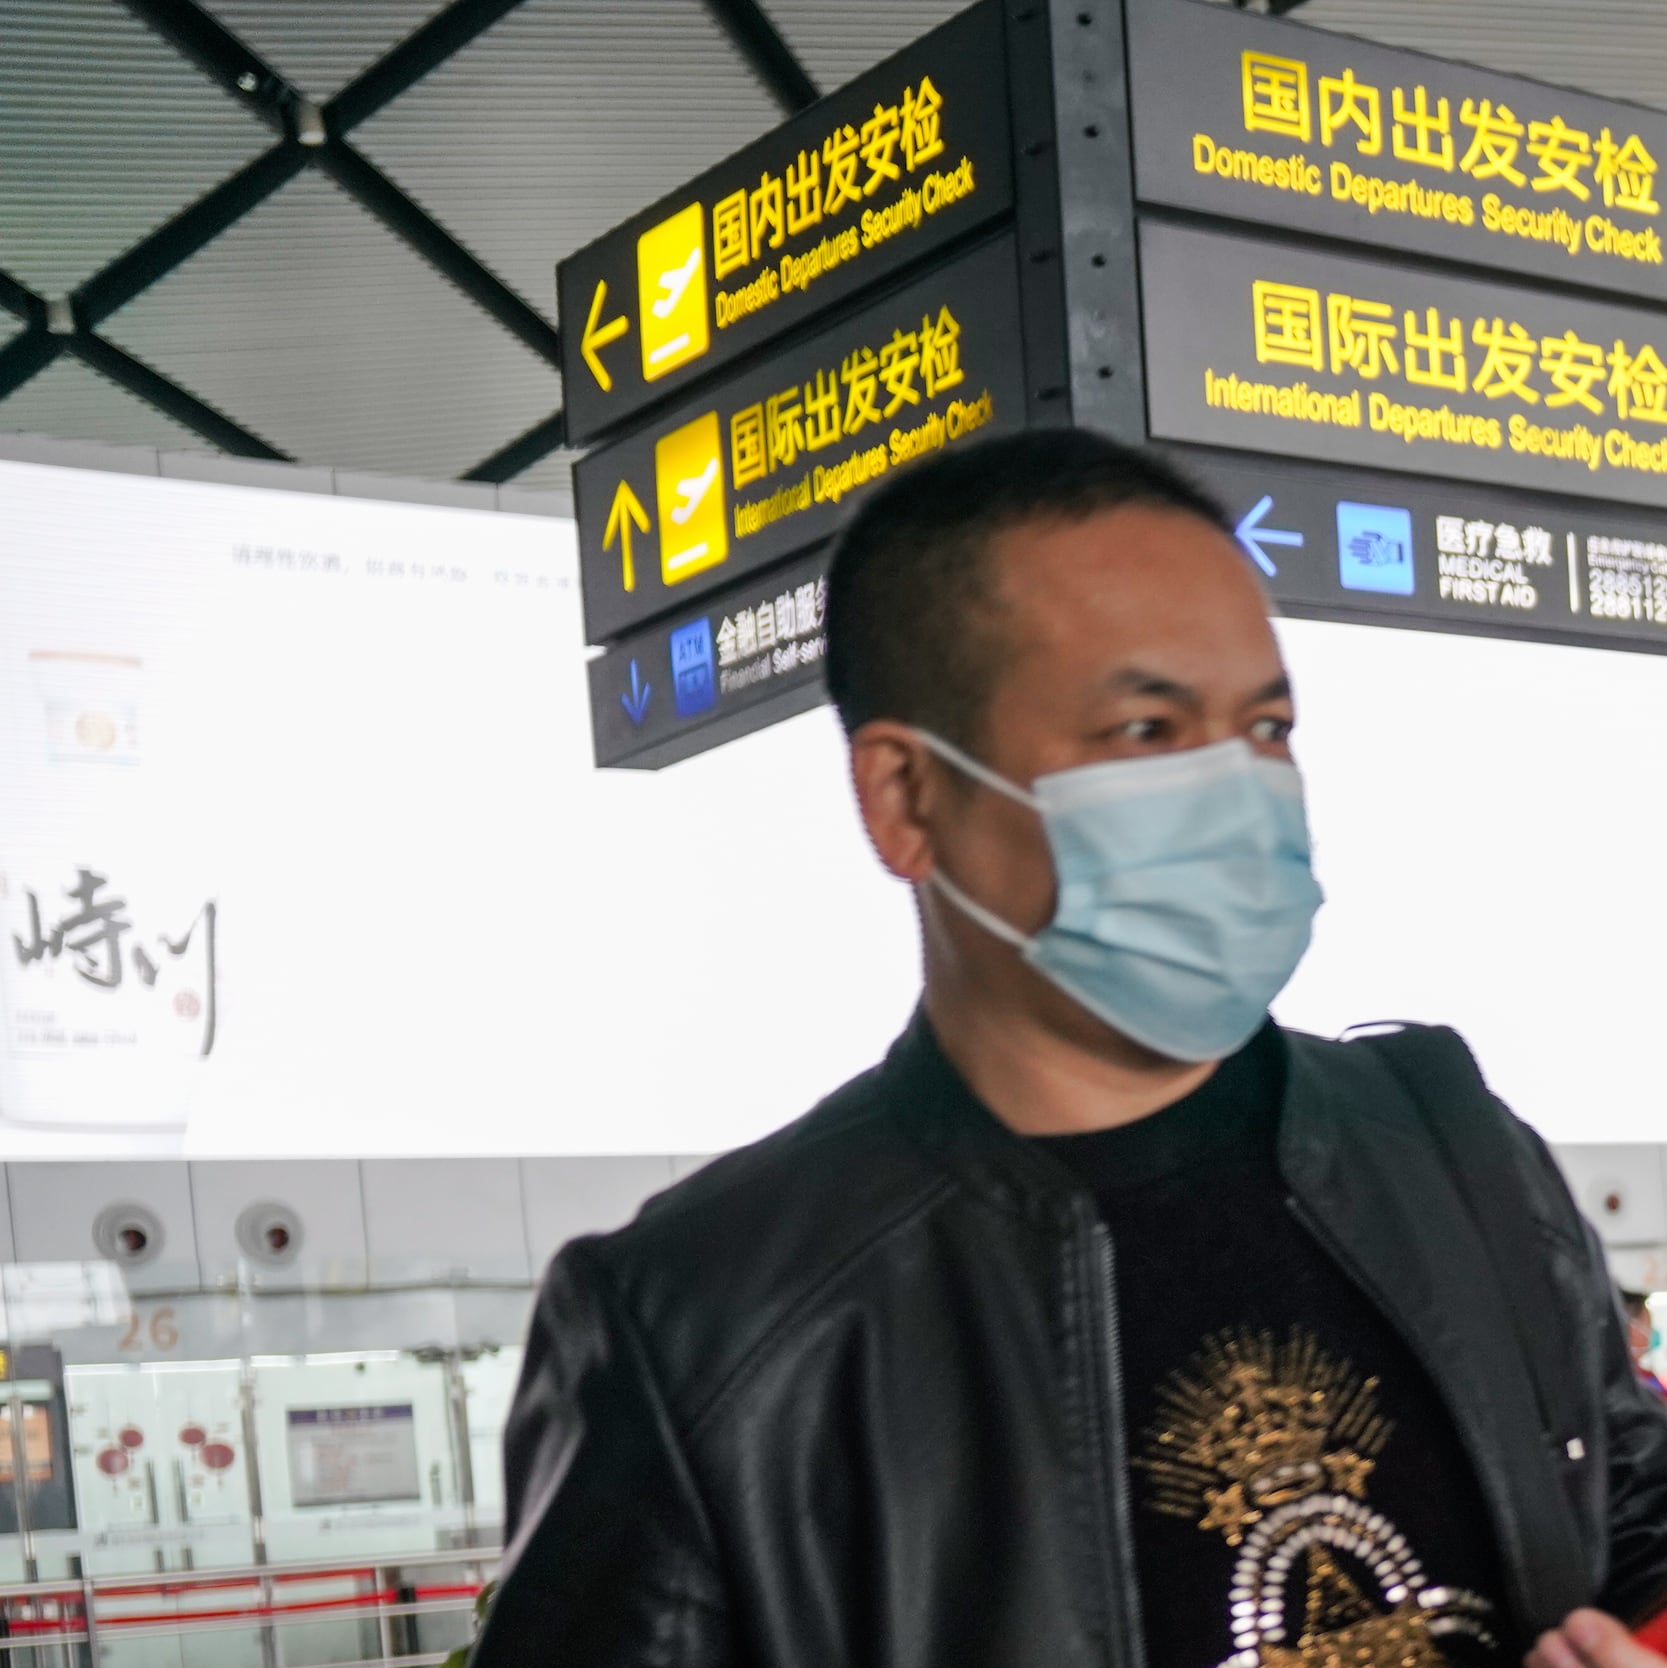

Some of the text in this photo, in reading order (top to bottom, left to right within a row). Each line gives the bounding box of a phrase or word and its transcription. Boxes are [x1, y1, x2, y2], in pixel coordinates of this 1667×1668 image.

[713, 76, 944, 281] 国内出发安检
[1241, 50, 1661, 216] 国内出发安检
[715, 155, 975, 329] Domestic Departures Security Check
[1192, 134, 1663, 264] Domestic Departures Security Check
[731, 306, 964, 490] 国际出发安检
[734, 387, 992, 539] International Departures Security Check
[1205, 369, 1362, 427] International
[1368, 392, 1502, 444] Departures
[1508, 414, 1602, 471] Security
[1436, 515, 1553, 566] 医疗急救
[1438, 553, 1529, 585] MEDICAL
[1440, 577, 1538, 609] FIRST AID
[720, 653, 771, 694] Financial
